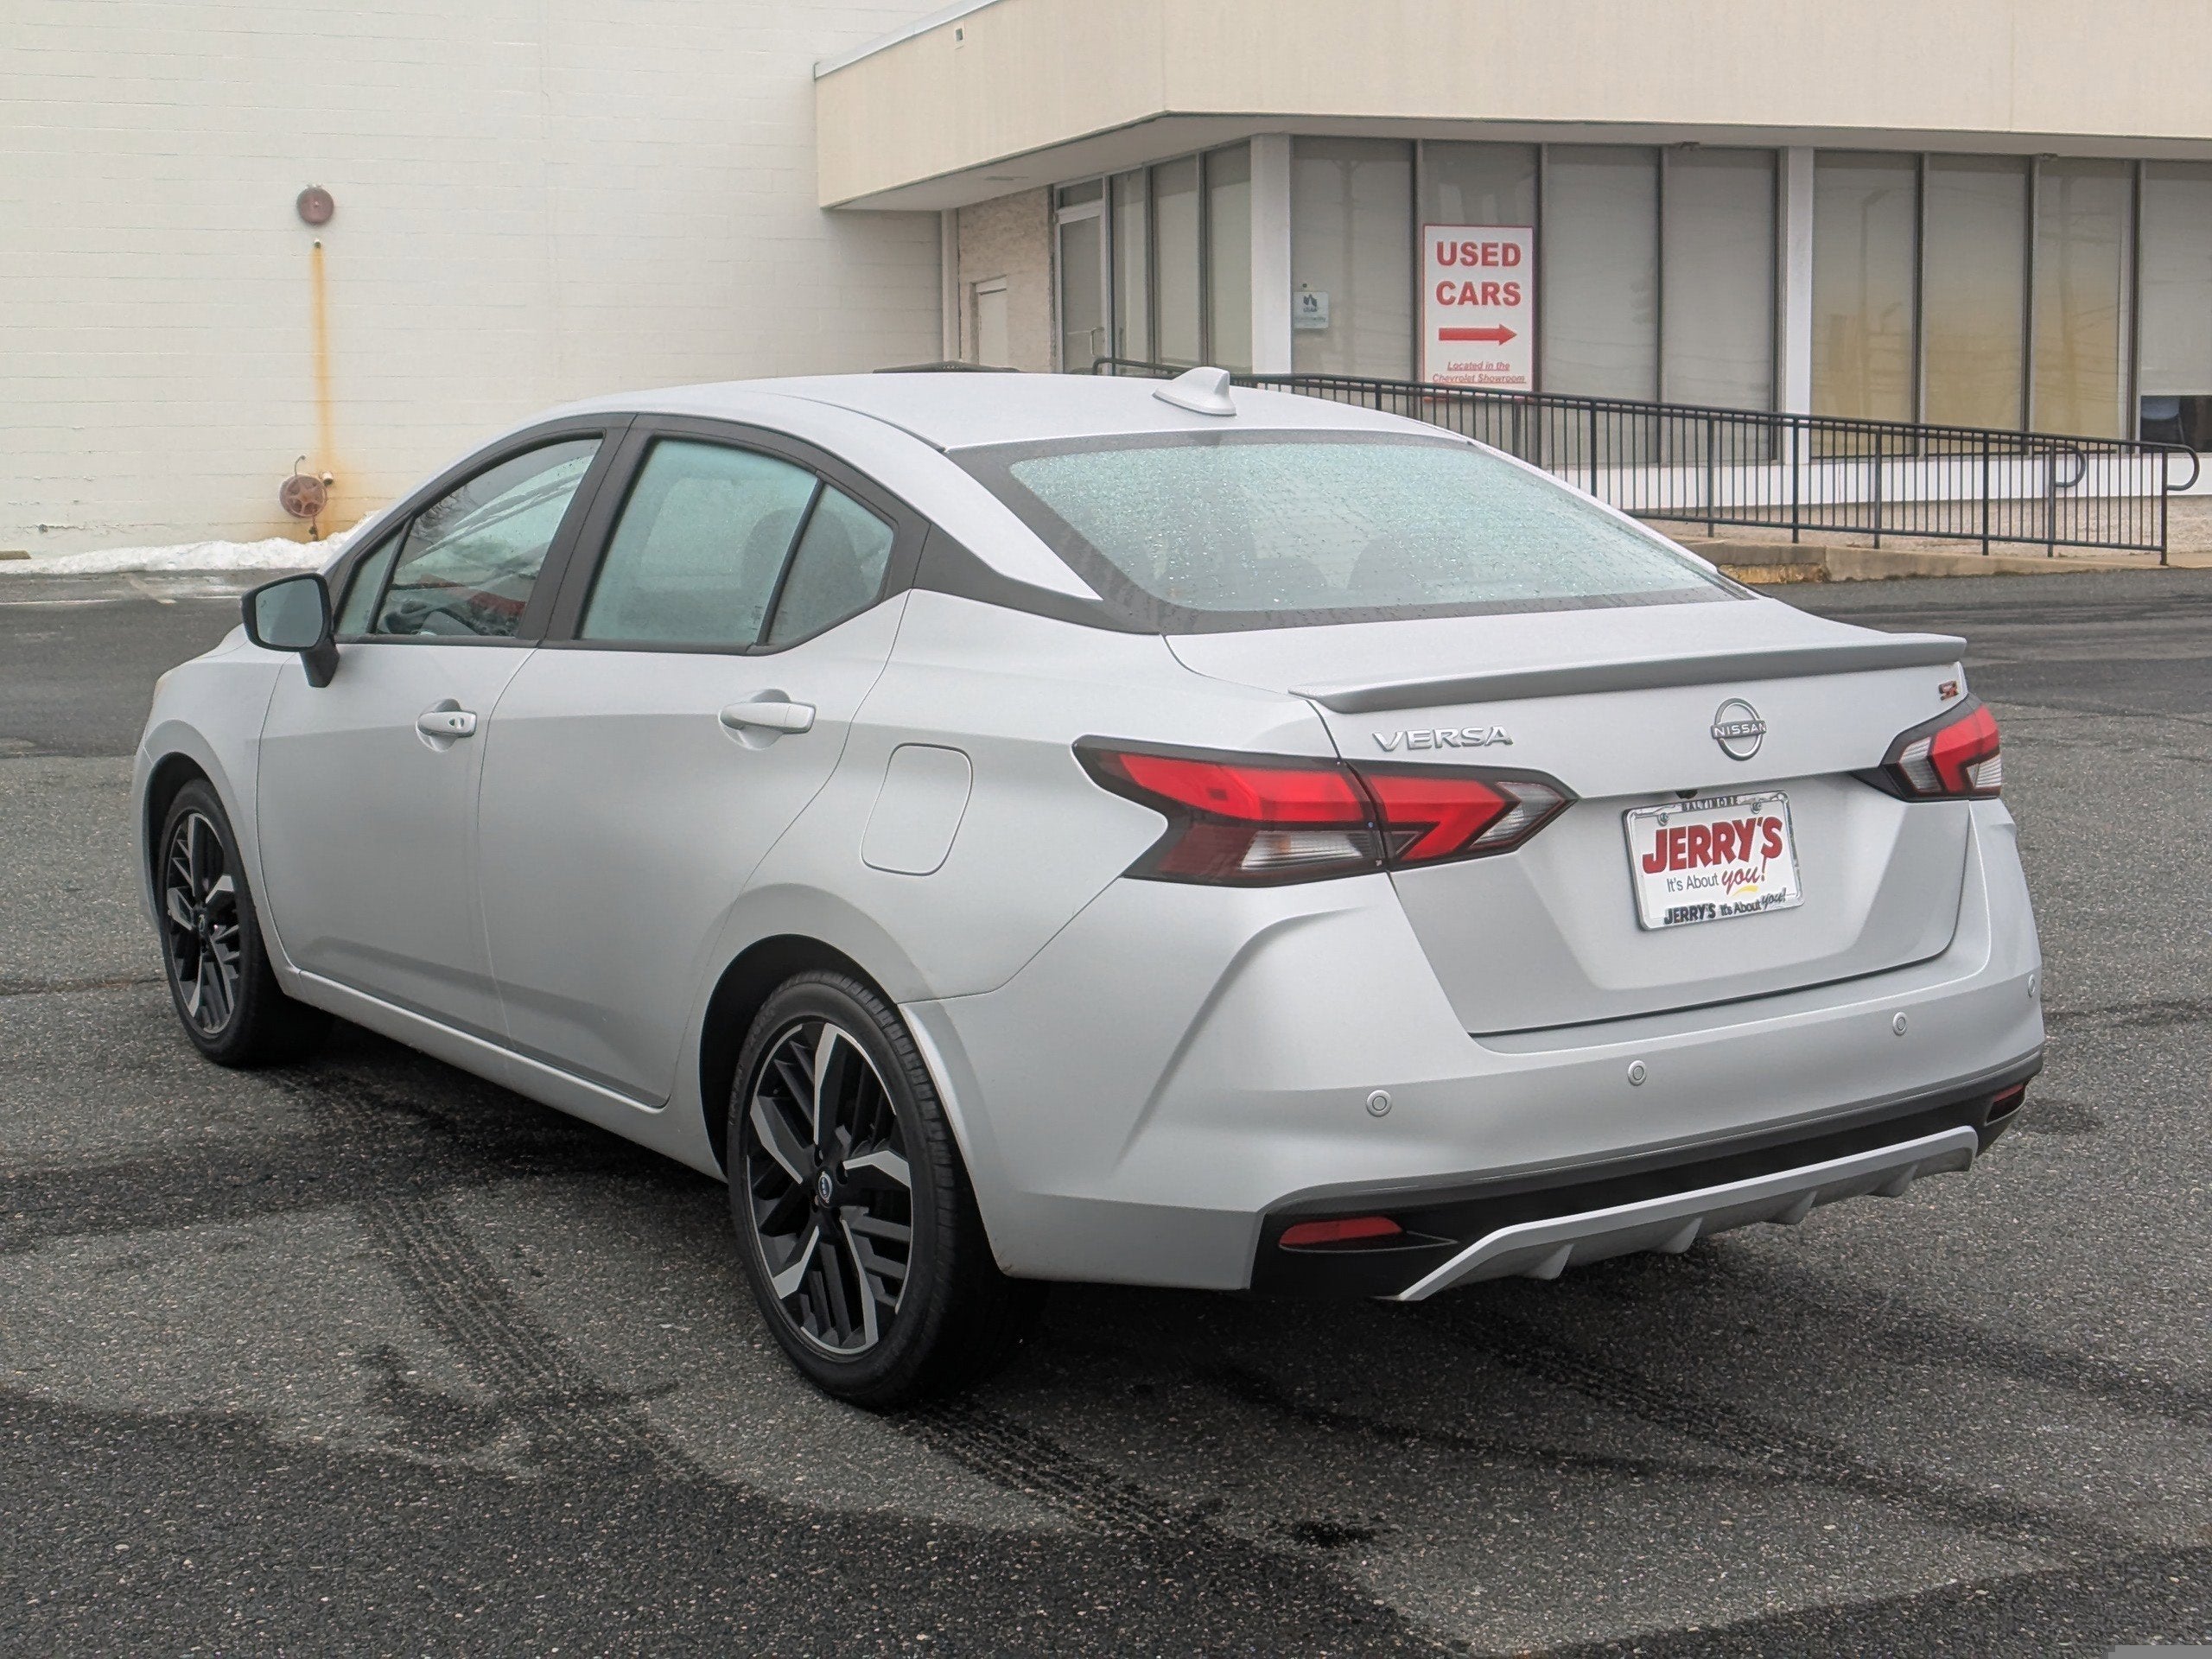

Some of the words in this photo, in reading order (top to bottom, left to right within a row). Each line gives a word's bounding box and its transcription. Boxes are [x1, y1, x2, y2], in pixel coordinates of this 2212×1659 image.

[1436, 241, 1522, 267] USED
[1435, 280, 1522, 307] CARS
[1433, 373, 1475, 383] Chevrolet
[1478, 374, 1526, 384] Showroom
[1447, 361, 1484, 371] Located
[1485, 361, 1494, 371] in
[1497, 361, 1510, 371] the
[1372, 726, 1513, 752] VERSA
[1713, 722, 1766, 736] NISSAN
[1642, 817, 1783, 874] JERRY'S
[1667, 878, 1683, 893] It's
[1687, 873, 1719, 890] About
[1721, 857, 1767, 895] you!
[1664, 903, 1716, 925] JERRY'S
[1720, 904, 1732, 916] It's
[1733, 899, 1761, 914] About
[1761, 887, 1787, 910] you!
